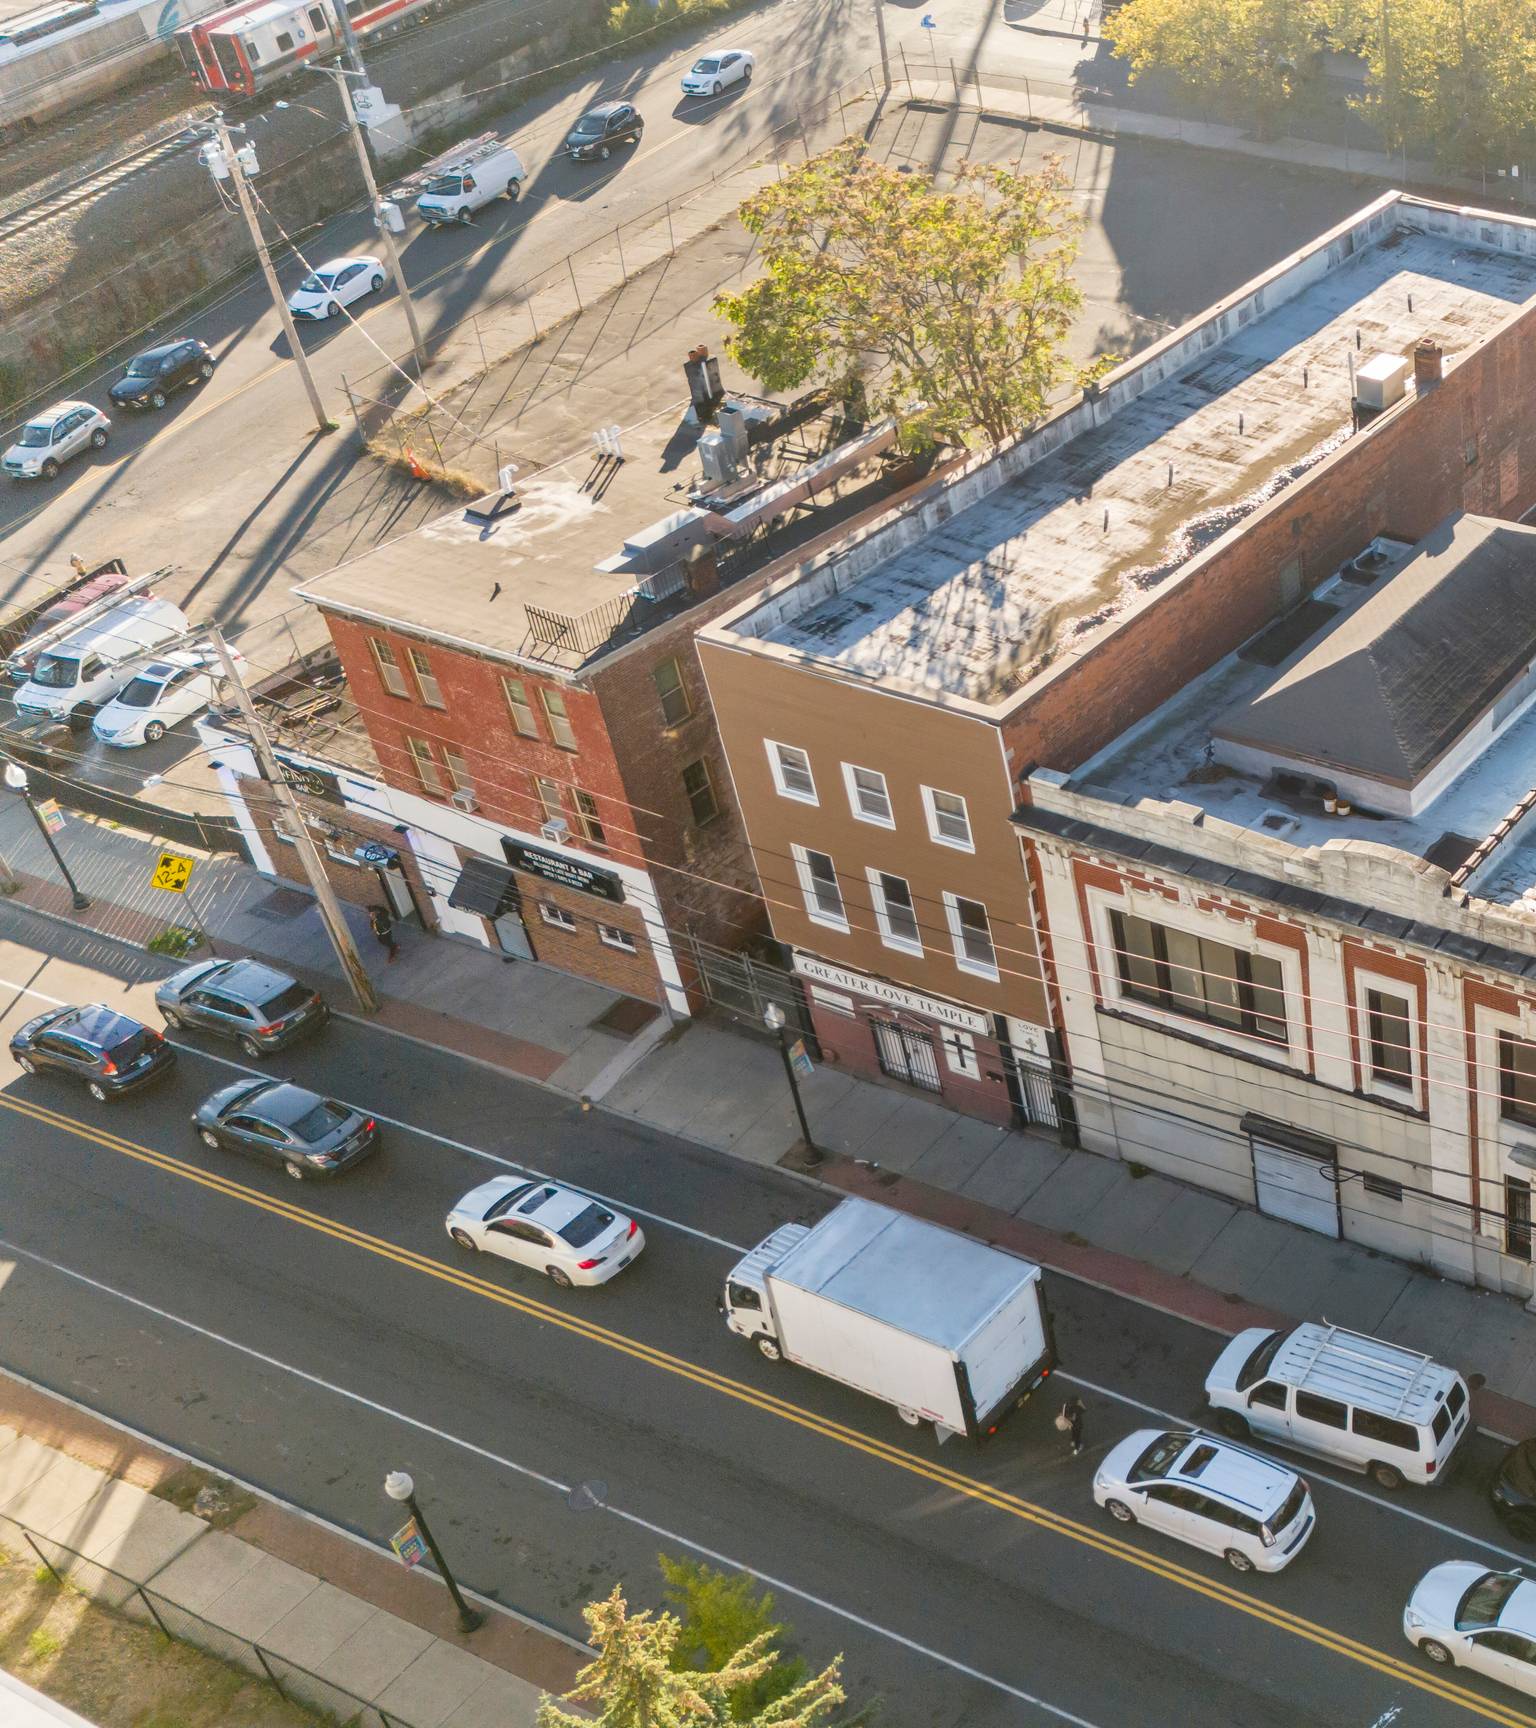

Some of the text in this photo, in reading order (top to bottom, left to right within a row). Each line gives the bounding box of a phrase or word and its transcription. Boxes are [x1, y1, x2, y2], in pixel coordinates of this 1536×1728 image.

[523, 850, 593, 880] RESTAURANT & BAR
[804, 961, 977, 1028] GREATER LOVE TEMPLE
